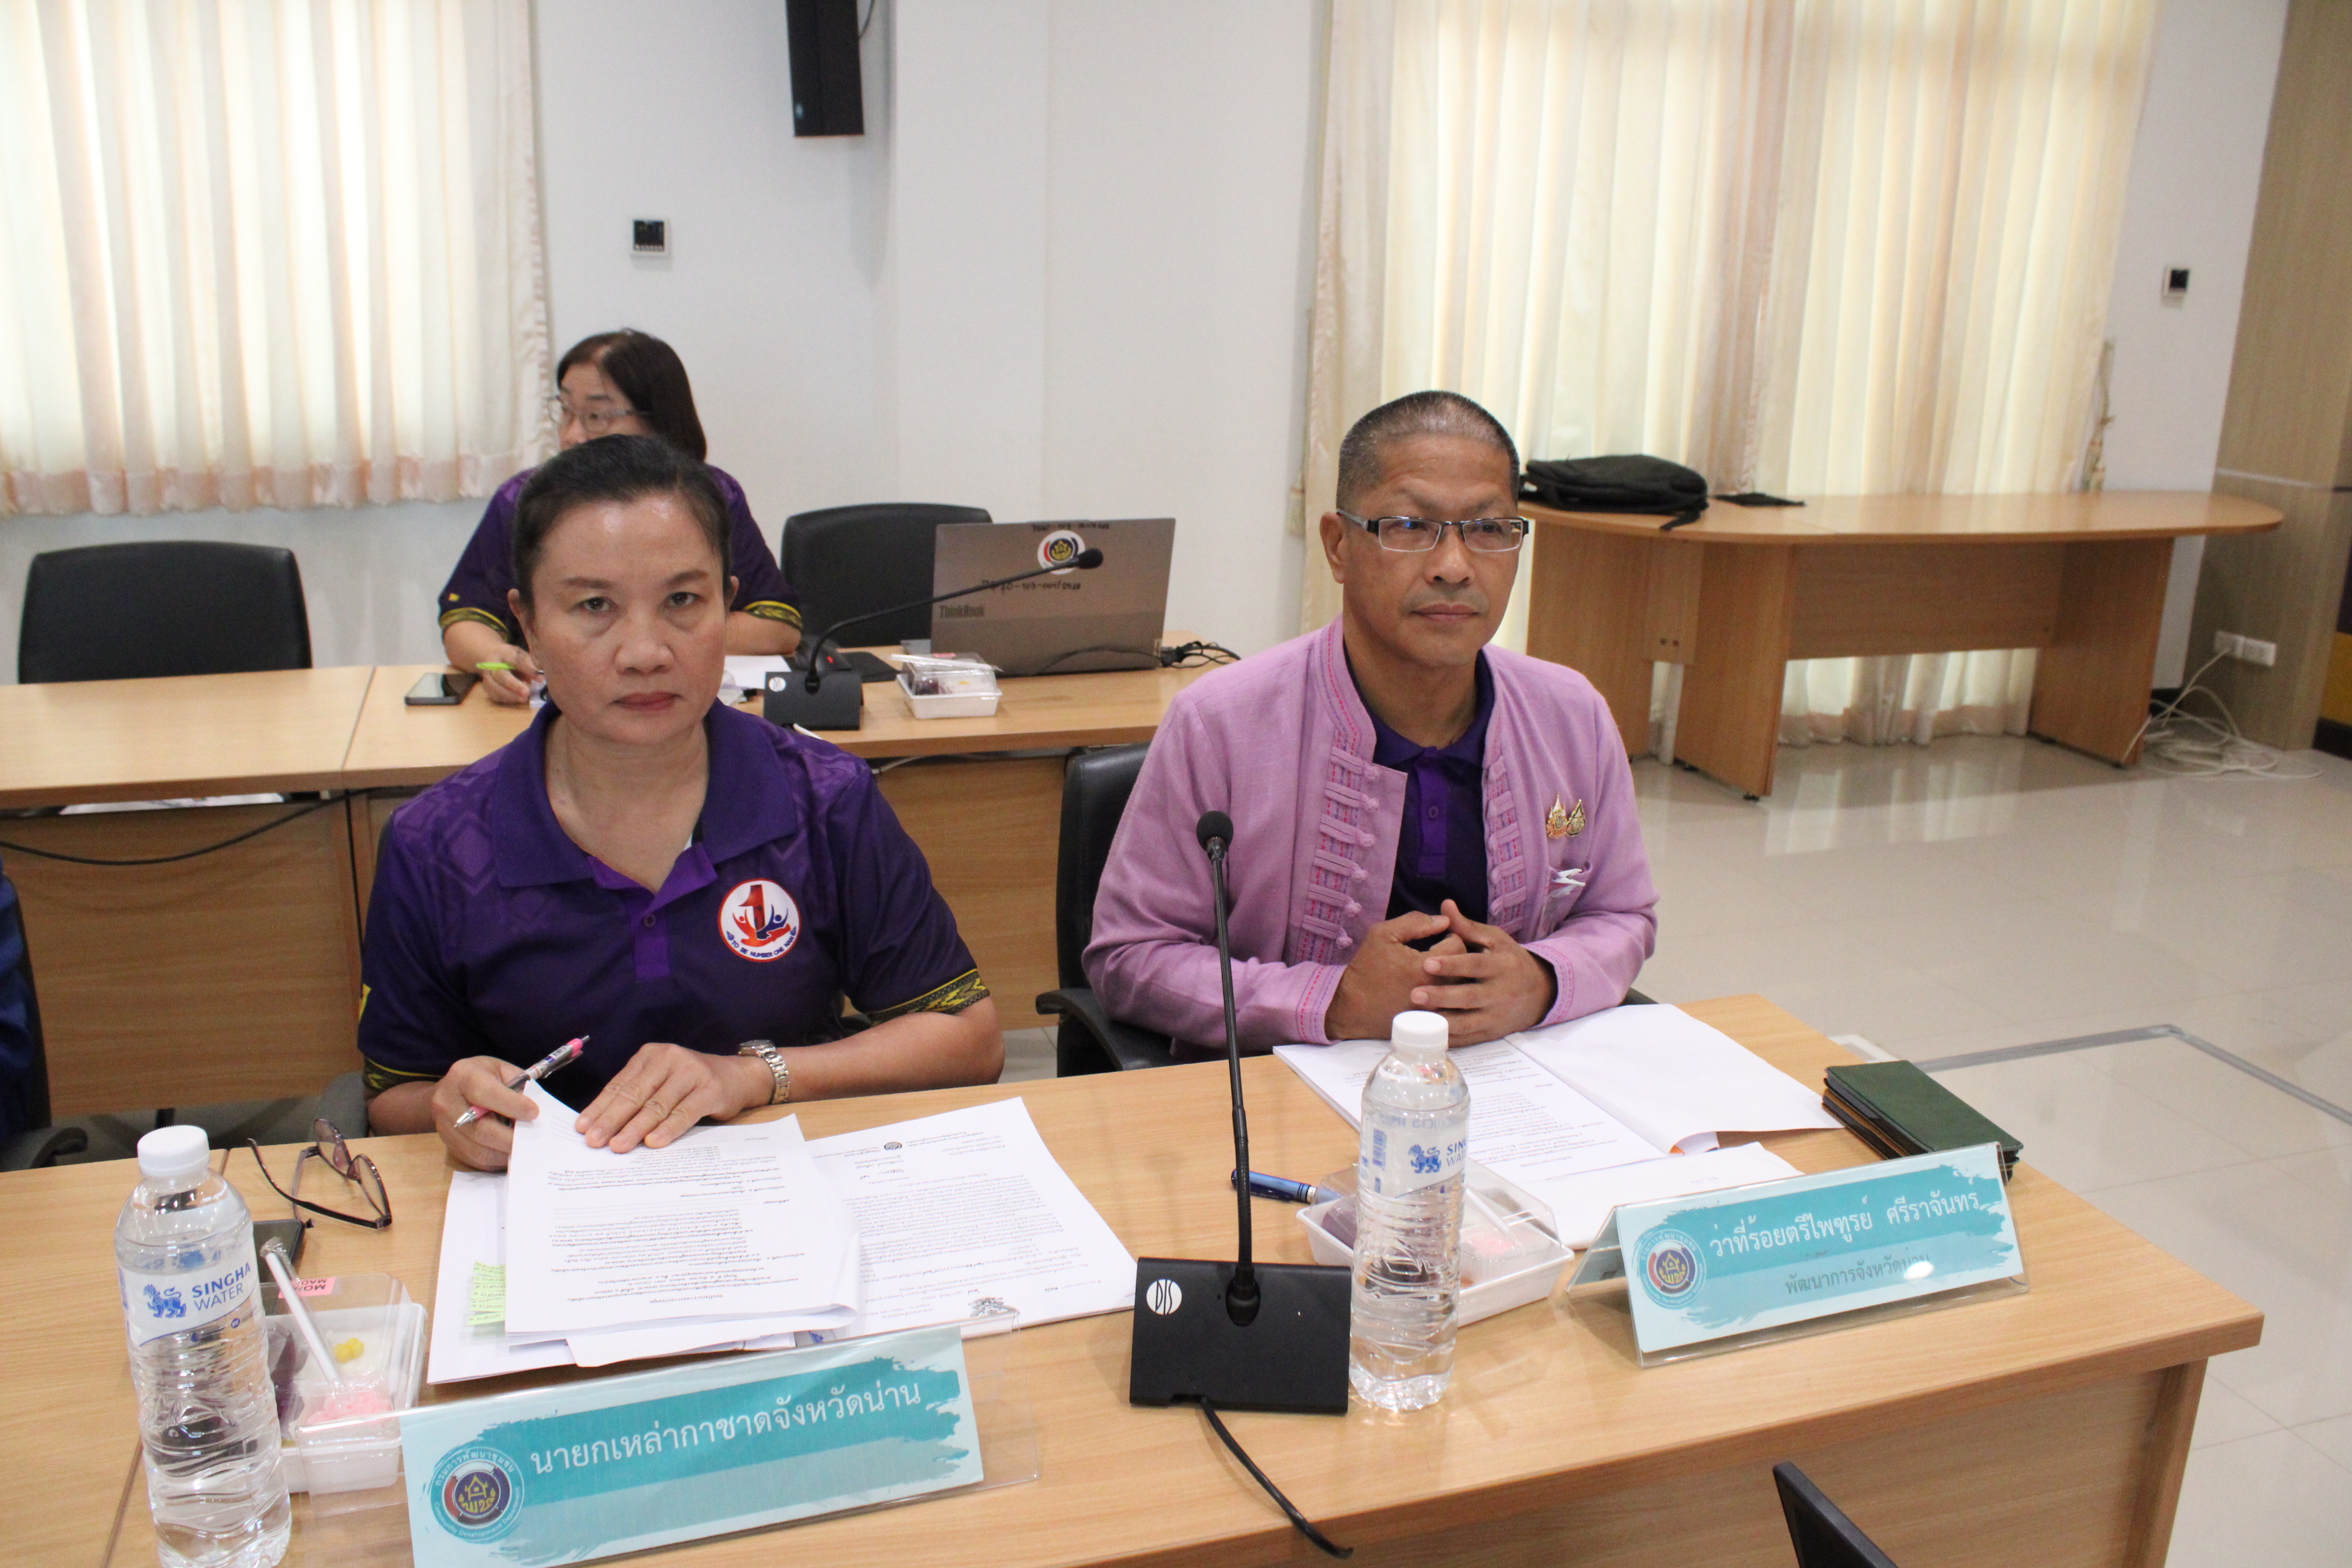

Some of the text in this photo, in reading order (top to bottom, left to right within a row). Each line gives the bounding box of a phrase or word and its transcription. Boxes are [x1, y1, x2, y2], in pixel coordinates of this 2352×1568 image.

[773, 946, 785, 955] ONE
[784, 936, 795, 948] NAN
[1710, 1177, 1979, 1257] ว่าที่ร้อยตรีไพฑูรย์ ศรีราจันทร์
[192, 1262, 251, 1298] SINGHA
[194, 1282, 244, 1311] WATER
[530, 1379, 921, 1475] นายกเหล่ากาชาดจังหวัดน่าน
[435, 1449, 515, 1487] กรมการพัฒนาชุมชน
[459, 1523, 502, 1538] Development
